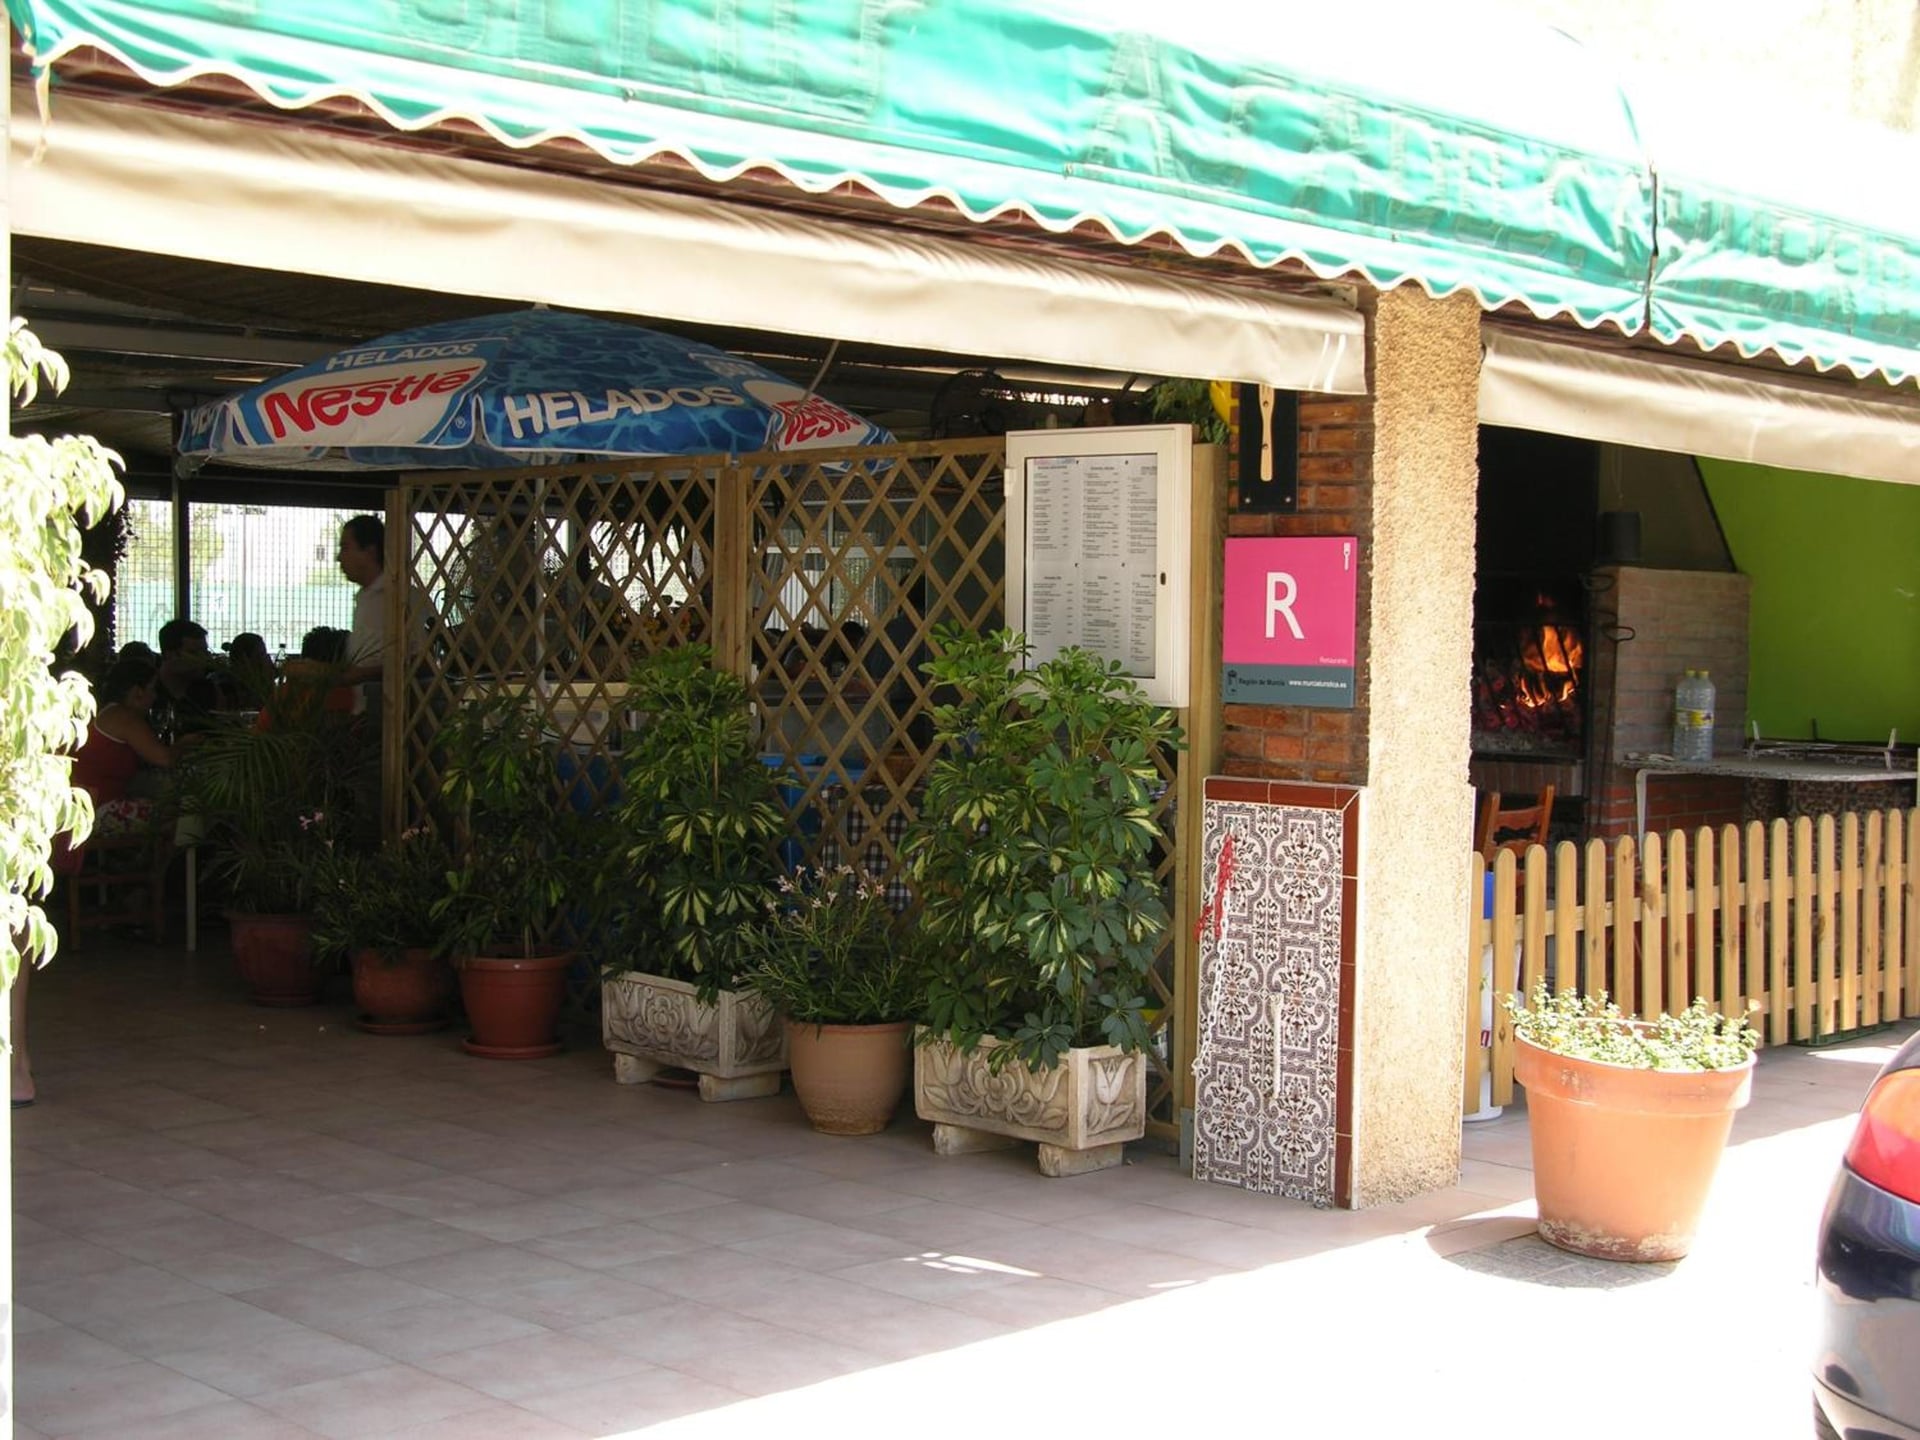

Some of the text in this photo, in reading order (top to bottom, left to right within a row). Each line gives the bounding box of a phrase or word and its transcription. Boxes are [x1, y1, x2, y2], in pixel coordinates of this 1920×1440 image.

[325, 342, 478, 372] HELADOS
[263, 365, 481, 438] Nestlé
[503, 387, 745, 439] HELADOS
[1265, 571, 1305, 640] R
